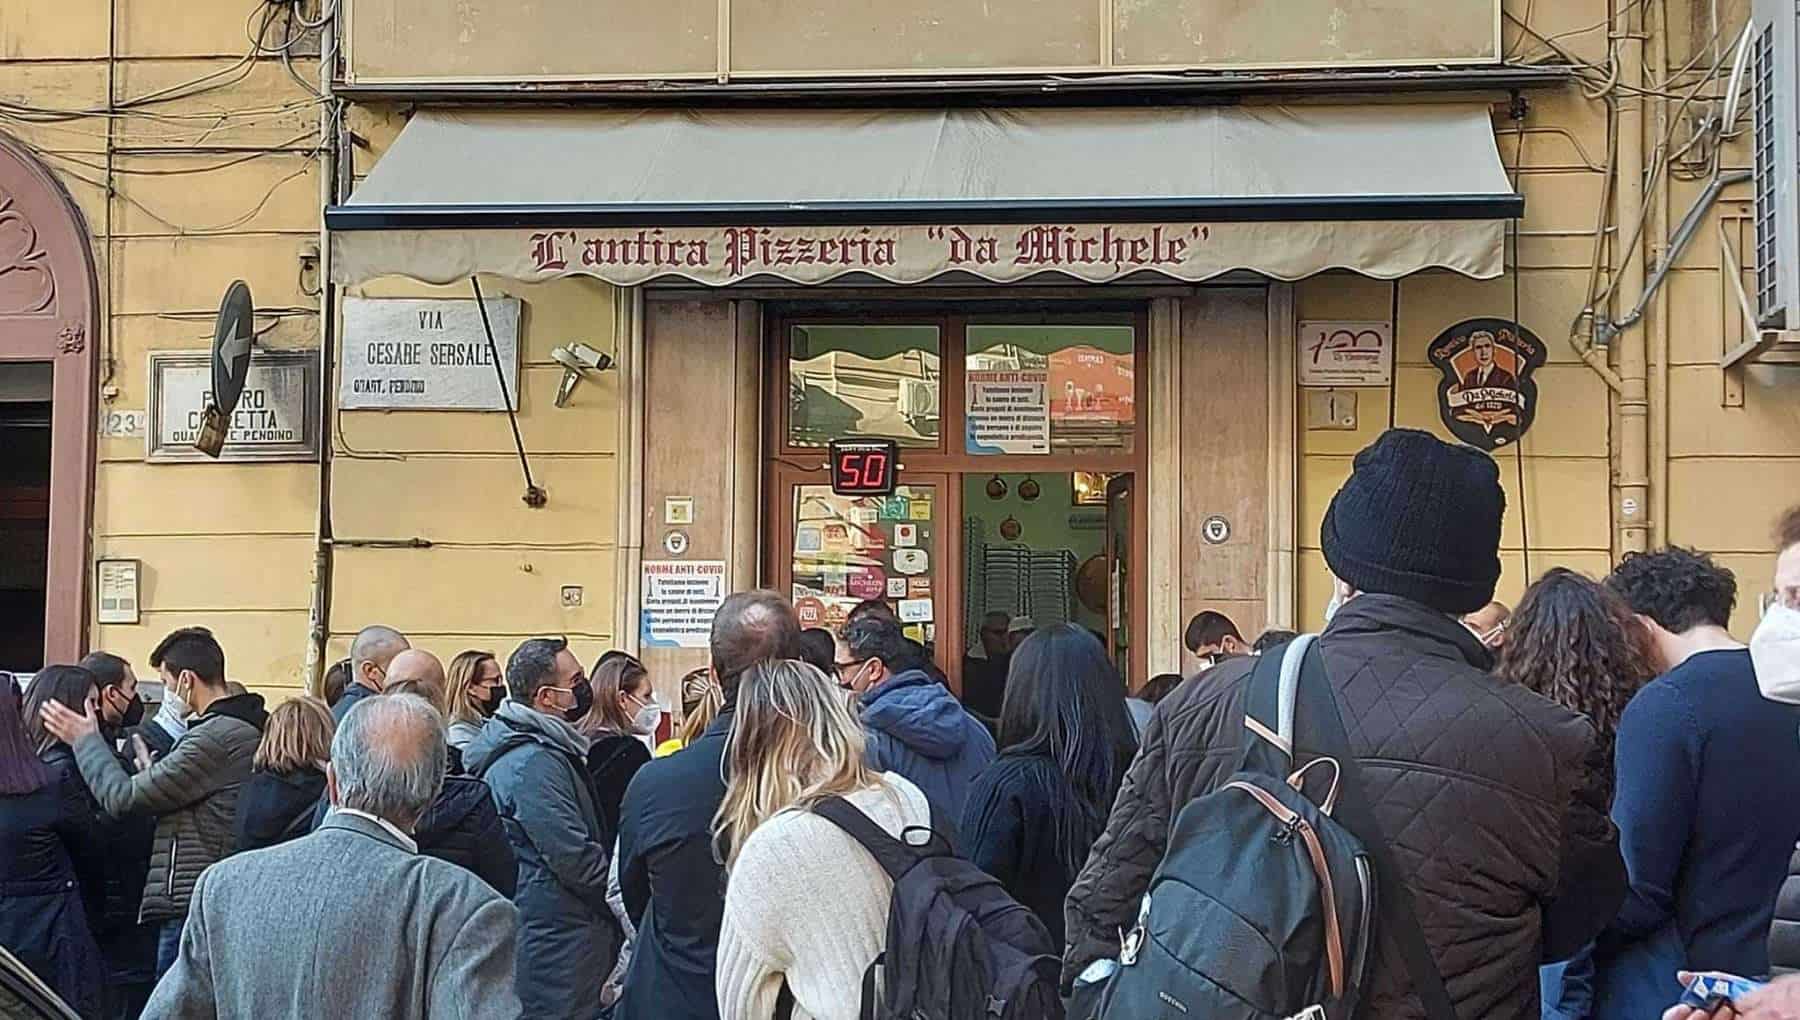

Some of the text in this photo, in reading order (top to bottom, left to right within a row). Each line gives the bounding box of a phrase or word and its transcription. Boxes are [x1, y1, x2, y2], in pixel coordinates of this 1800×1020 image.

[530, 229, 709, 272] L'antica
[724, 227, 896, 277] Pizzeria
[419, 311, 443, 329] VIA
[367, 343, 493, 366] CESARE SERSALE
[999, 373, 1018, 382] ANTI
[202, 390, 265, 409] PRO
[188, 409, 278, 430] CETTA
[243, 430, 293, 441] PENDINO
[840, 454, 887, 487] 50
[645, 565, 723, 575] NORME ANTI COVID
